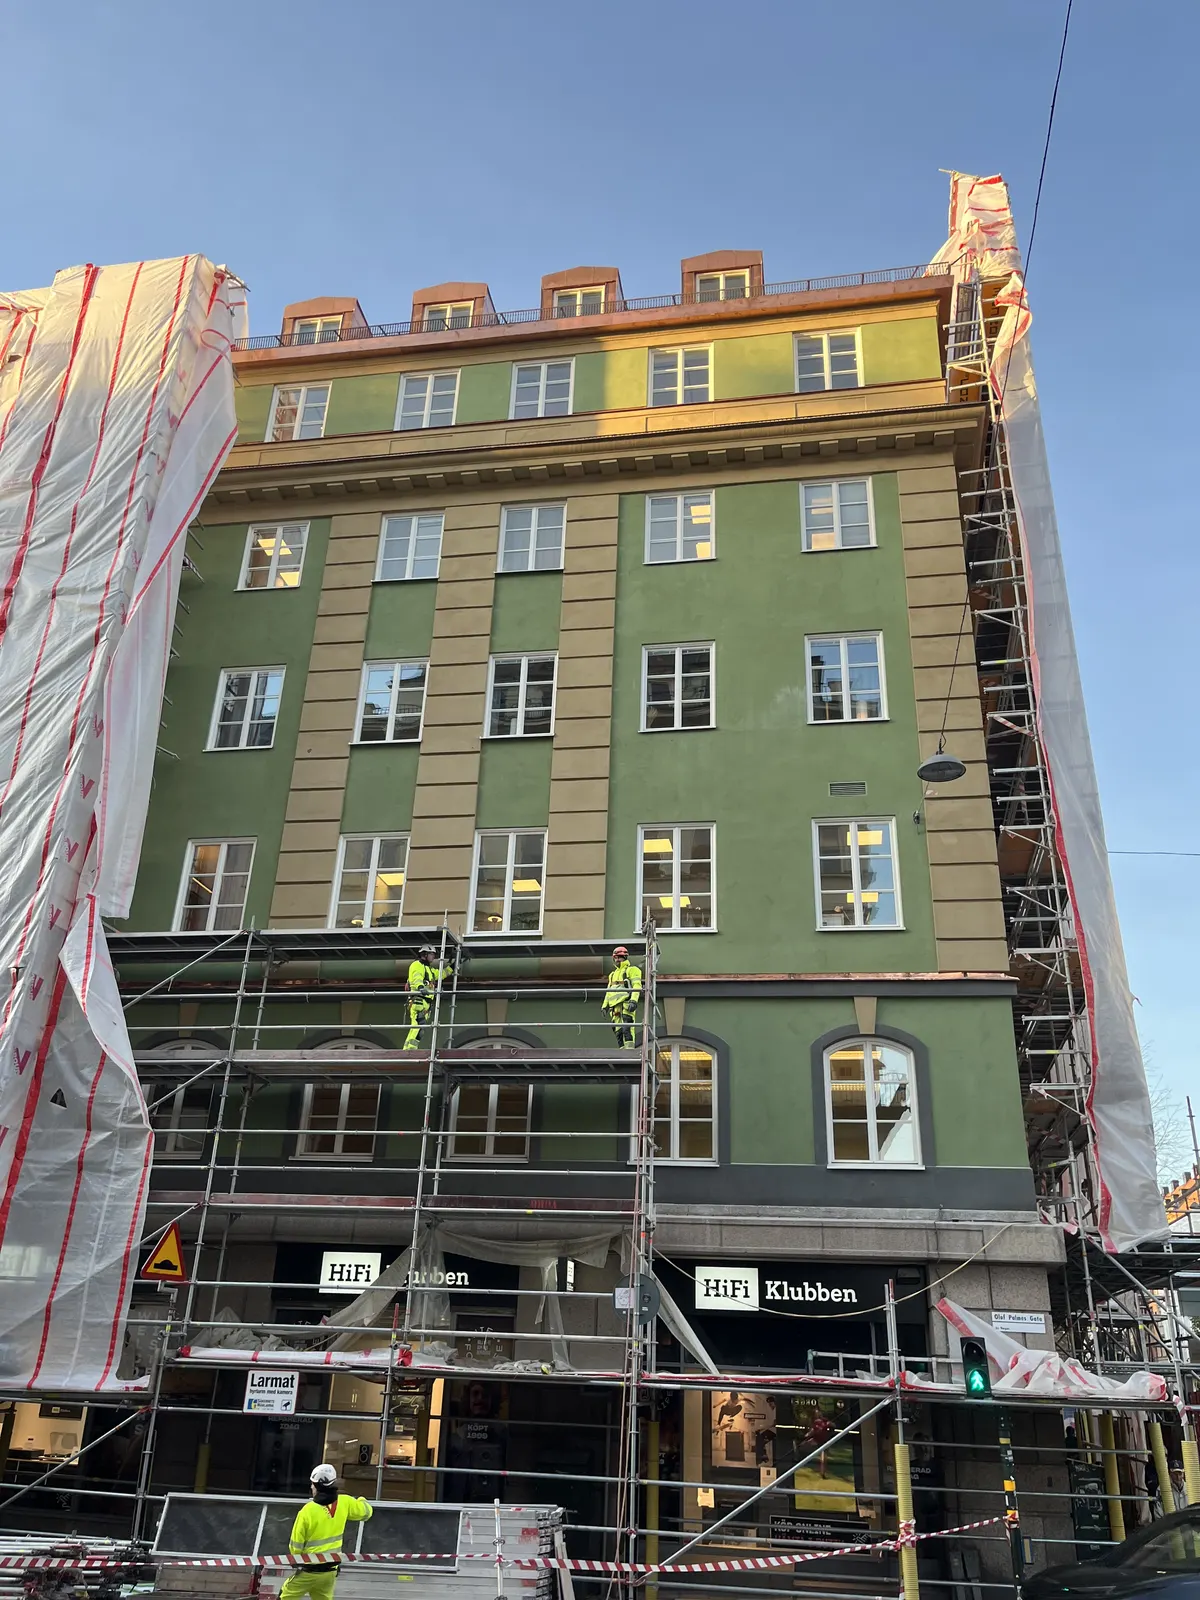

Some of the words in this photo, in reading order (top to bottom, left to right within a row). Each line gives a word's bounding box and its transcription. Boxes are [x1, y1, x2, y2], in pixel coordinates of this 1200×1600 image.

[328, 1264, 371, 1282] HiFi
[703, 1279, 750, 1298] HiFi
[765, 1280, 858, 1303] Klubben
[250, 1373, 295, 1388] Larmat
